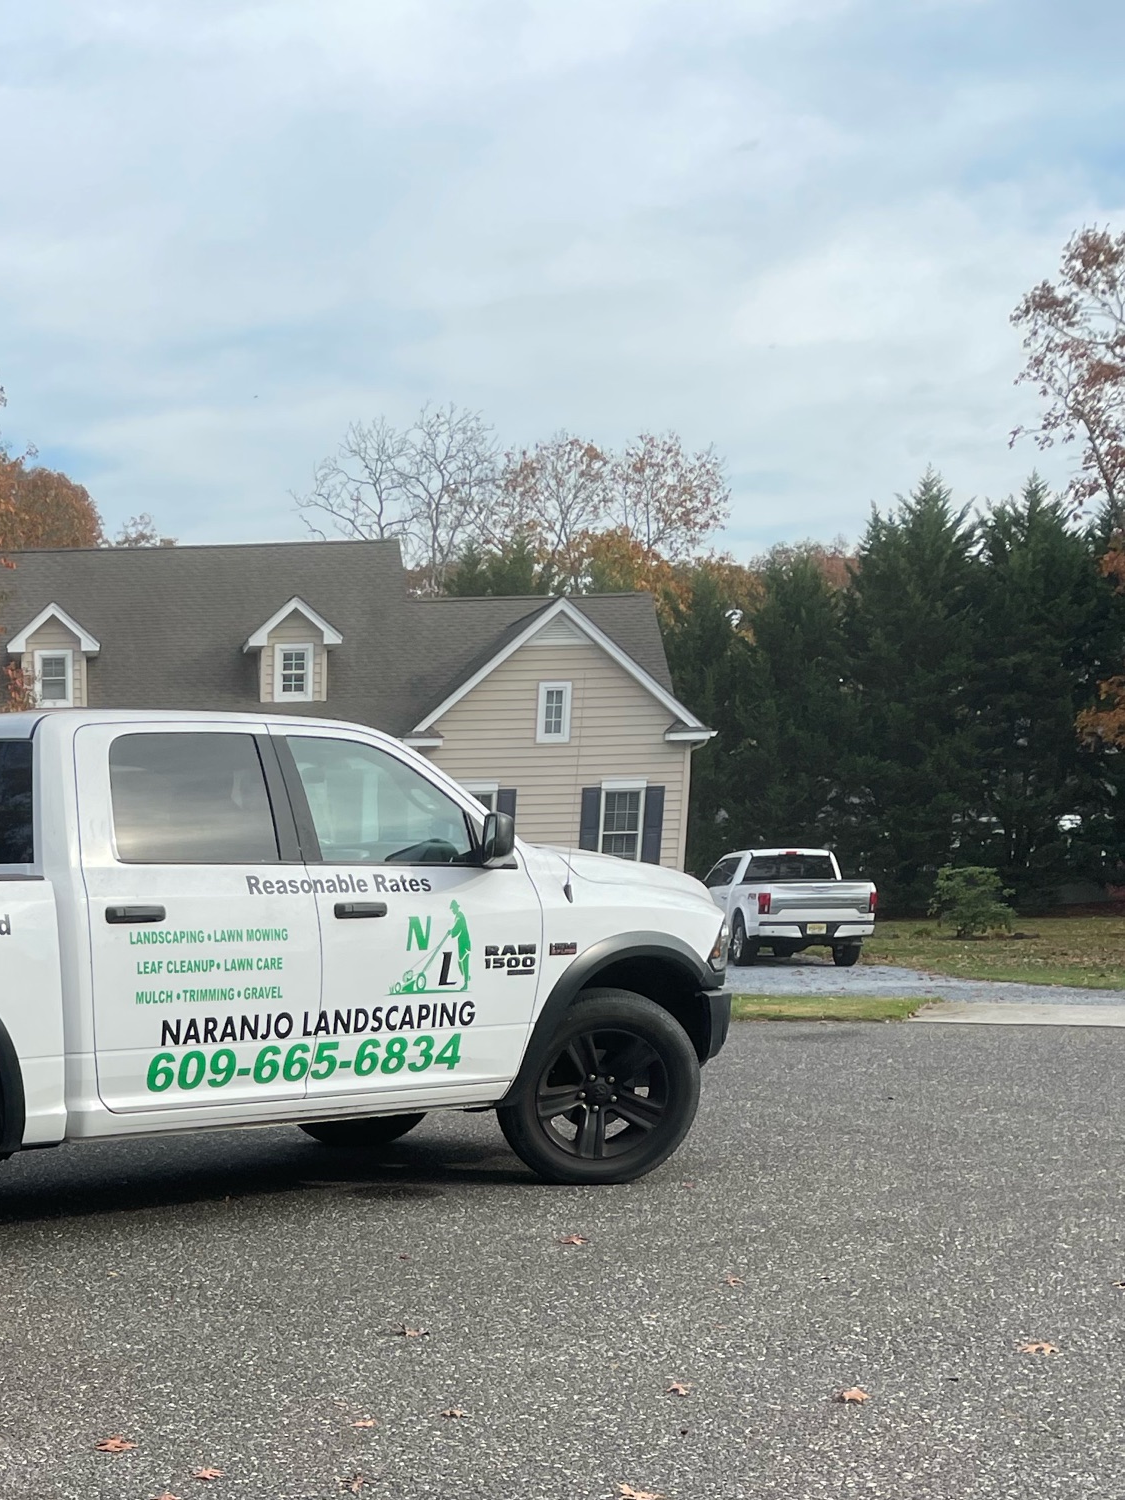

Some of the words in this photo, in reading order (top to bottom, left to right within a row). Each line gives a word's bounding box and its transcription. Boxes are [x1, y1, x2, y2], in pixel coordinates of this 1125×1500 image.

[246, 873, 369, 895] Reasonable
[373, 873, 432, 893] Rates
[129, 930, 205, 945] LANDSCAPING
[213, 929, 244, 943] LAWN
[246, 928, 288, 942] MOWING
[406, 915, 432, 951] N
[484, 943, 537, 957] RAM
[137, 960, 163, 975] LEAF
[166, 959, 215, 974] CLEANUP
[224, 958, 254, 972] LAWN
[256, 957, 283, 971] CARE
[438, 951, 458, 986] L
[484, 956, 536, 969] 1500
[135, 990, 174, 1005] MULCH
[181, 988, 235, 1002] TRIMMING
[243, 986, 283, 1000] GRAVEL
[160, 1012, 294, 1047] NARANJO
[302, 1000, 476, 1037] LANDSCAPING
[146, 1032, 462, 1093] 609-665-6834
